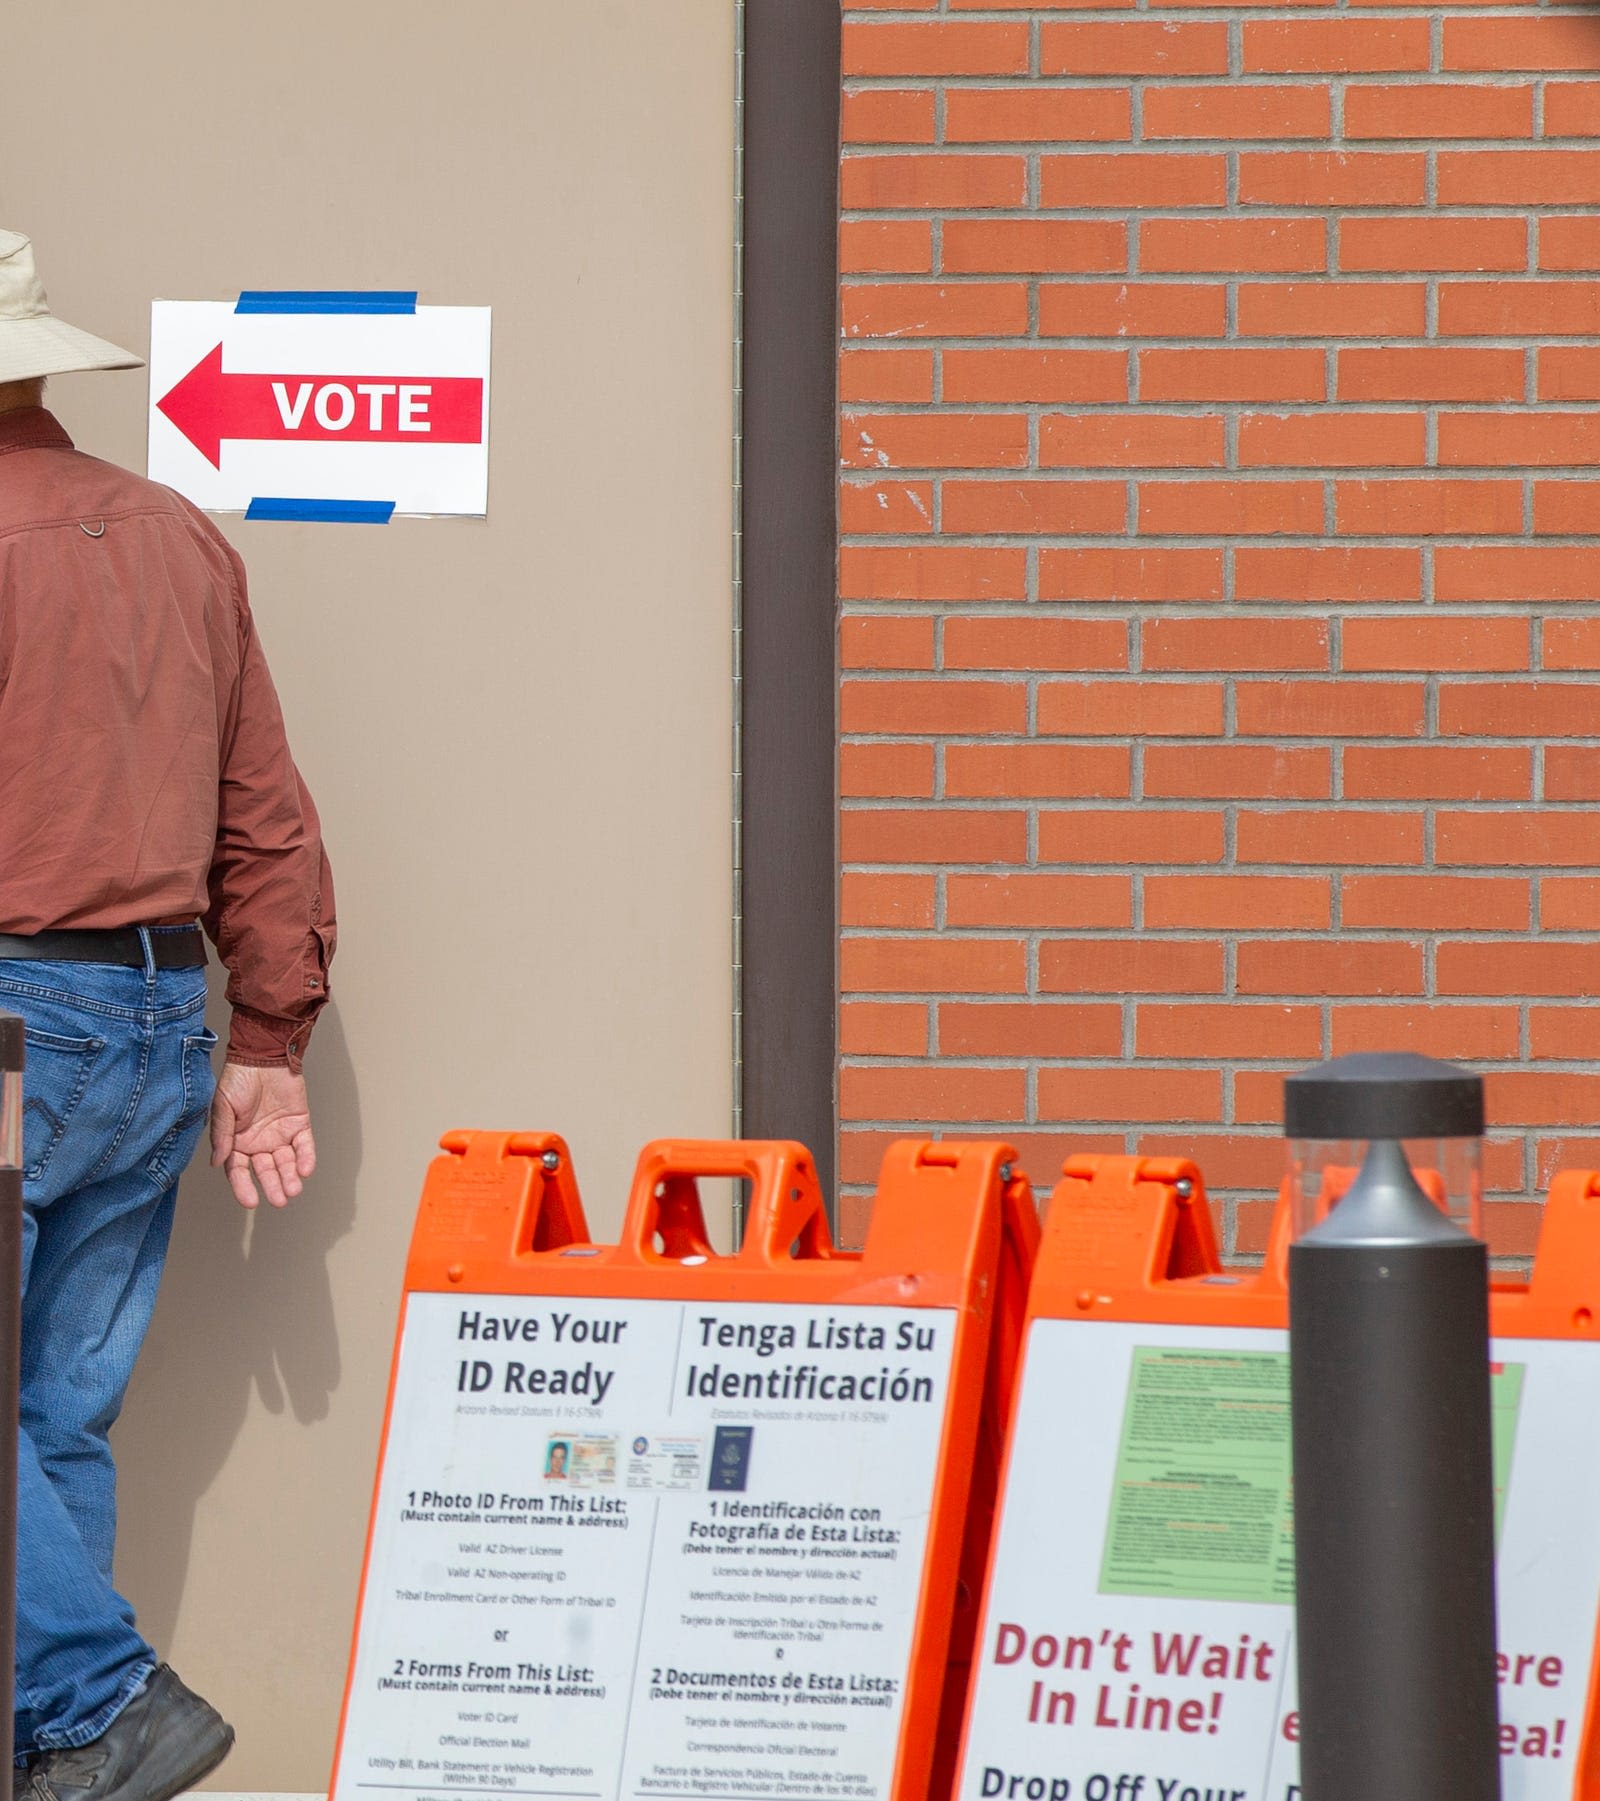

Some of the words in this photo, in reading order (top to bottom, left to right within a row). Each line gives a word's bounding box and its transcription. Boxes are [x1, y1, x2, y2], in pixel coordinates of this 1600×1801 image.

[271, 382, 432, 432] VOTE
[456, 1310, 539, 1342] Have
[549, 1312, 626, 1344] Your
[698, 1317, 796, 1358] Tenga
[806, 1319, 886, 1351] Lista
[895, 1321, 935, 1352] Su
[457, 1360, 494, 1393] ID
[504, 1361, 612, 1405] Ready
[686, 1365, 934, 1403] Identificación
[408, 1491, 416, 1507] 1
[421, 1492, 472, 1509] Photo
[477, 1493, 495, 1509] ID
[500, 1494, 544, 1511] From
[550, 1496, 585, 1512] This
[589, 1497, 627, 1514] List:
[710, 1501, 718, 1517] 1
[722, 1502, 845, 1520] Identificación
[849, 1508, 881, 1521] con
[401, 1509, 435, 1524] (Must
[438, 1511, 482, 1524] contain
[484, 1513, 528, 1525] current
[530, 1516, 563, 1526] name
[566, 1515, 575, 1527] &
[578, 1515, 629, 1530] address)
[689, 1521, 780, 1544] Fotografía
[784, 1524, 806, 1540] de
[810, 1525, 848, 1542] Esta
[852, 1526, 901, 1544] Lista:
[683, 1543, 713, 1556] (Debe
[714, 1545, 743, 1555] tener
[746, 1544, 757, 1556] el
[758, 1545, 799, 1557] nombre
[800, 1549, 807, 1560] y
[809, 1546, 859, 1558] dirección
[860, 1548, 898, 1561] actual)
[495, 1629, 510, 1642] or
[776, 1648, 785, 1659] o
[993, 1622, 1133, 1673] Don't
[1152, 1632, 1274, 1682] Wait
[394, 1660, 404, 1676] 2
[408, 1660, 462, 1678] Forms
[467, 1663, 512, 1680] From
[517, 1664, 552, 1681] This
[556, 1666, 595, 1684] List:
[652, 1668, 662, 1685] 2
[666, 1669, 777, 1688] Documentos
[781, 1673, 803, 1689] de
[807, 1673, 845, 1690] Esta
[849, 1675, 899, 1693] Lista:
[378, 1678, 412, 1693] (Must
[414, 1679, 459, 1692] contain
[462, 1682, 505, 1694] current
[508, 1685, 541, 1695] name
[544, 1683, 553, 1695] &
[555, 1684, 606, 1699] address)
[651, 1687, 683, 1701] (Debe
[686, 1690, 718, 1700] tener
[722, 1690, 733, 1701] el
[735, 1690, 781, 1702] nombre
[784, 1694, 790, 1706] y
[793, 1692, 848, 1705] dirección
[850, 1694, 893, 1708] actual)
[1027, 1680, 1076, 1725] In
[1094, 1683, 1223, 1735] Line!
[981, 1767, 1070, 1801] Drop
[1085, 1774, 1146, 1801] Off
[1156, 1778, 1247, 1801] Your
